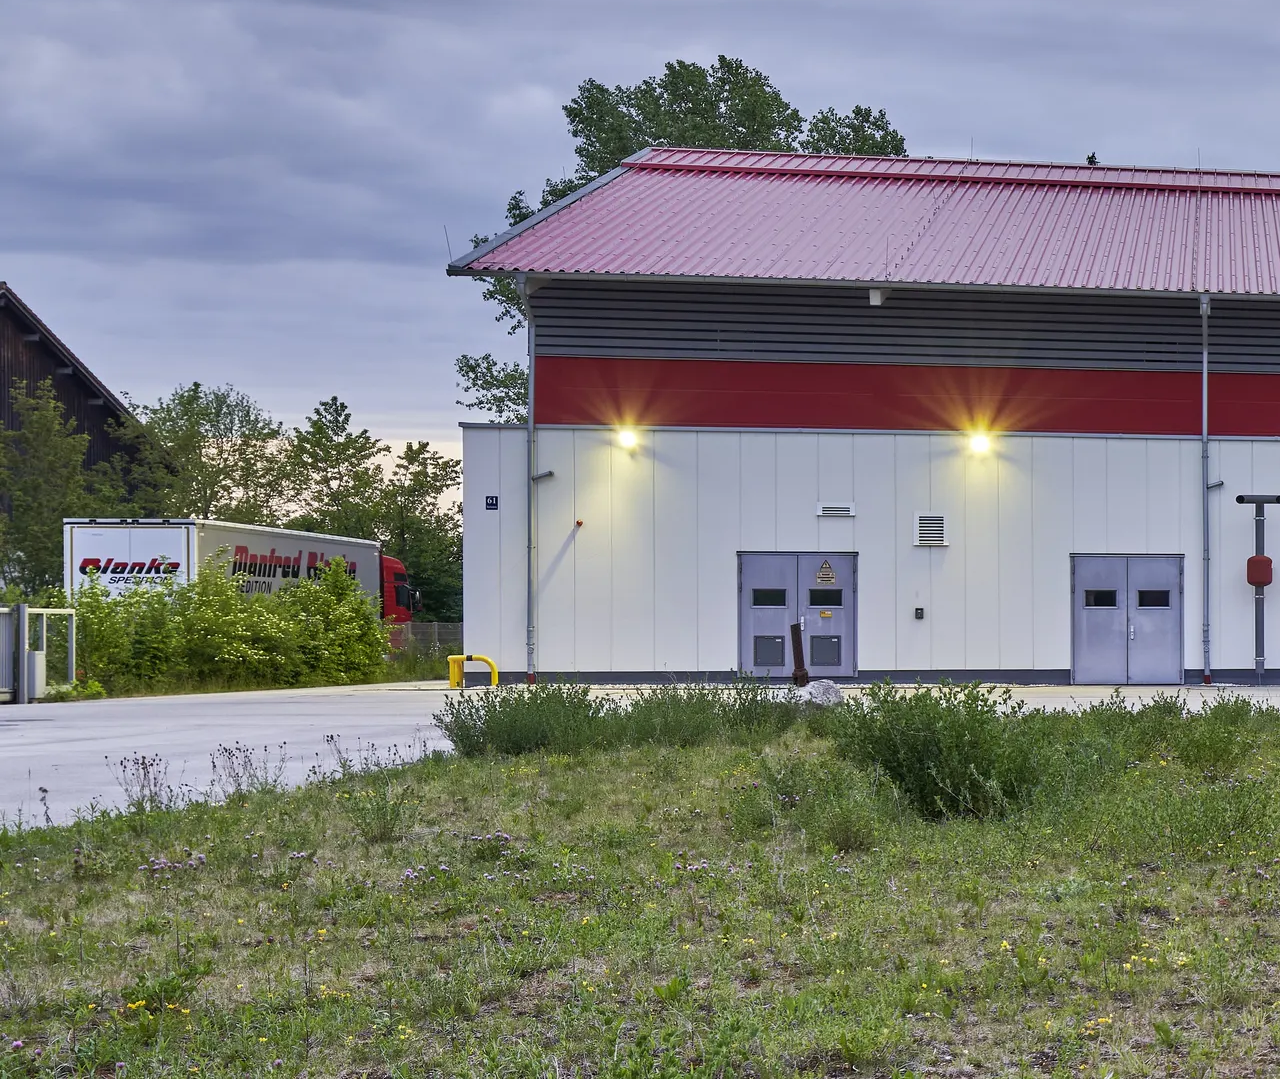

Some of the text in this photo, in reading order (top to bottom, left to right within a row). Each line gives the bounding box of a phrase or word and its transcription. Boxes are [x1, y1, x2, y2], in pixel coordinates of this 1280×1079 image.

[79, 558, 180, 576] Blanke
[232, 545, 357, 582] Manfred Blae
[236, 580, 273, 594] EDITION
